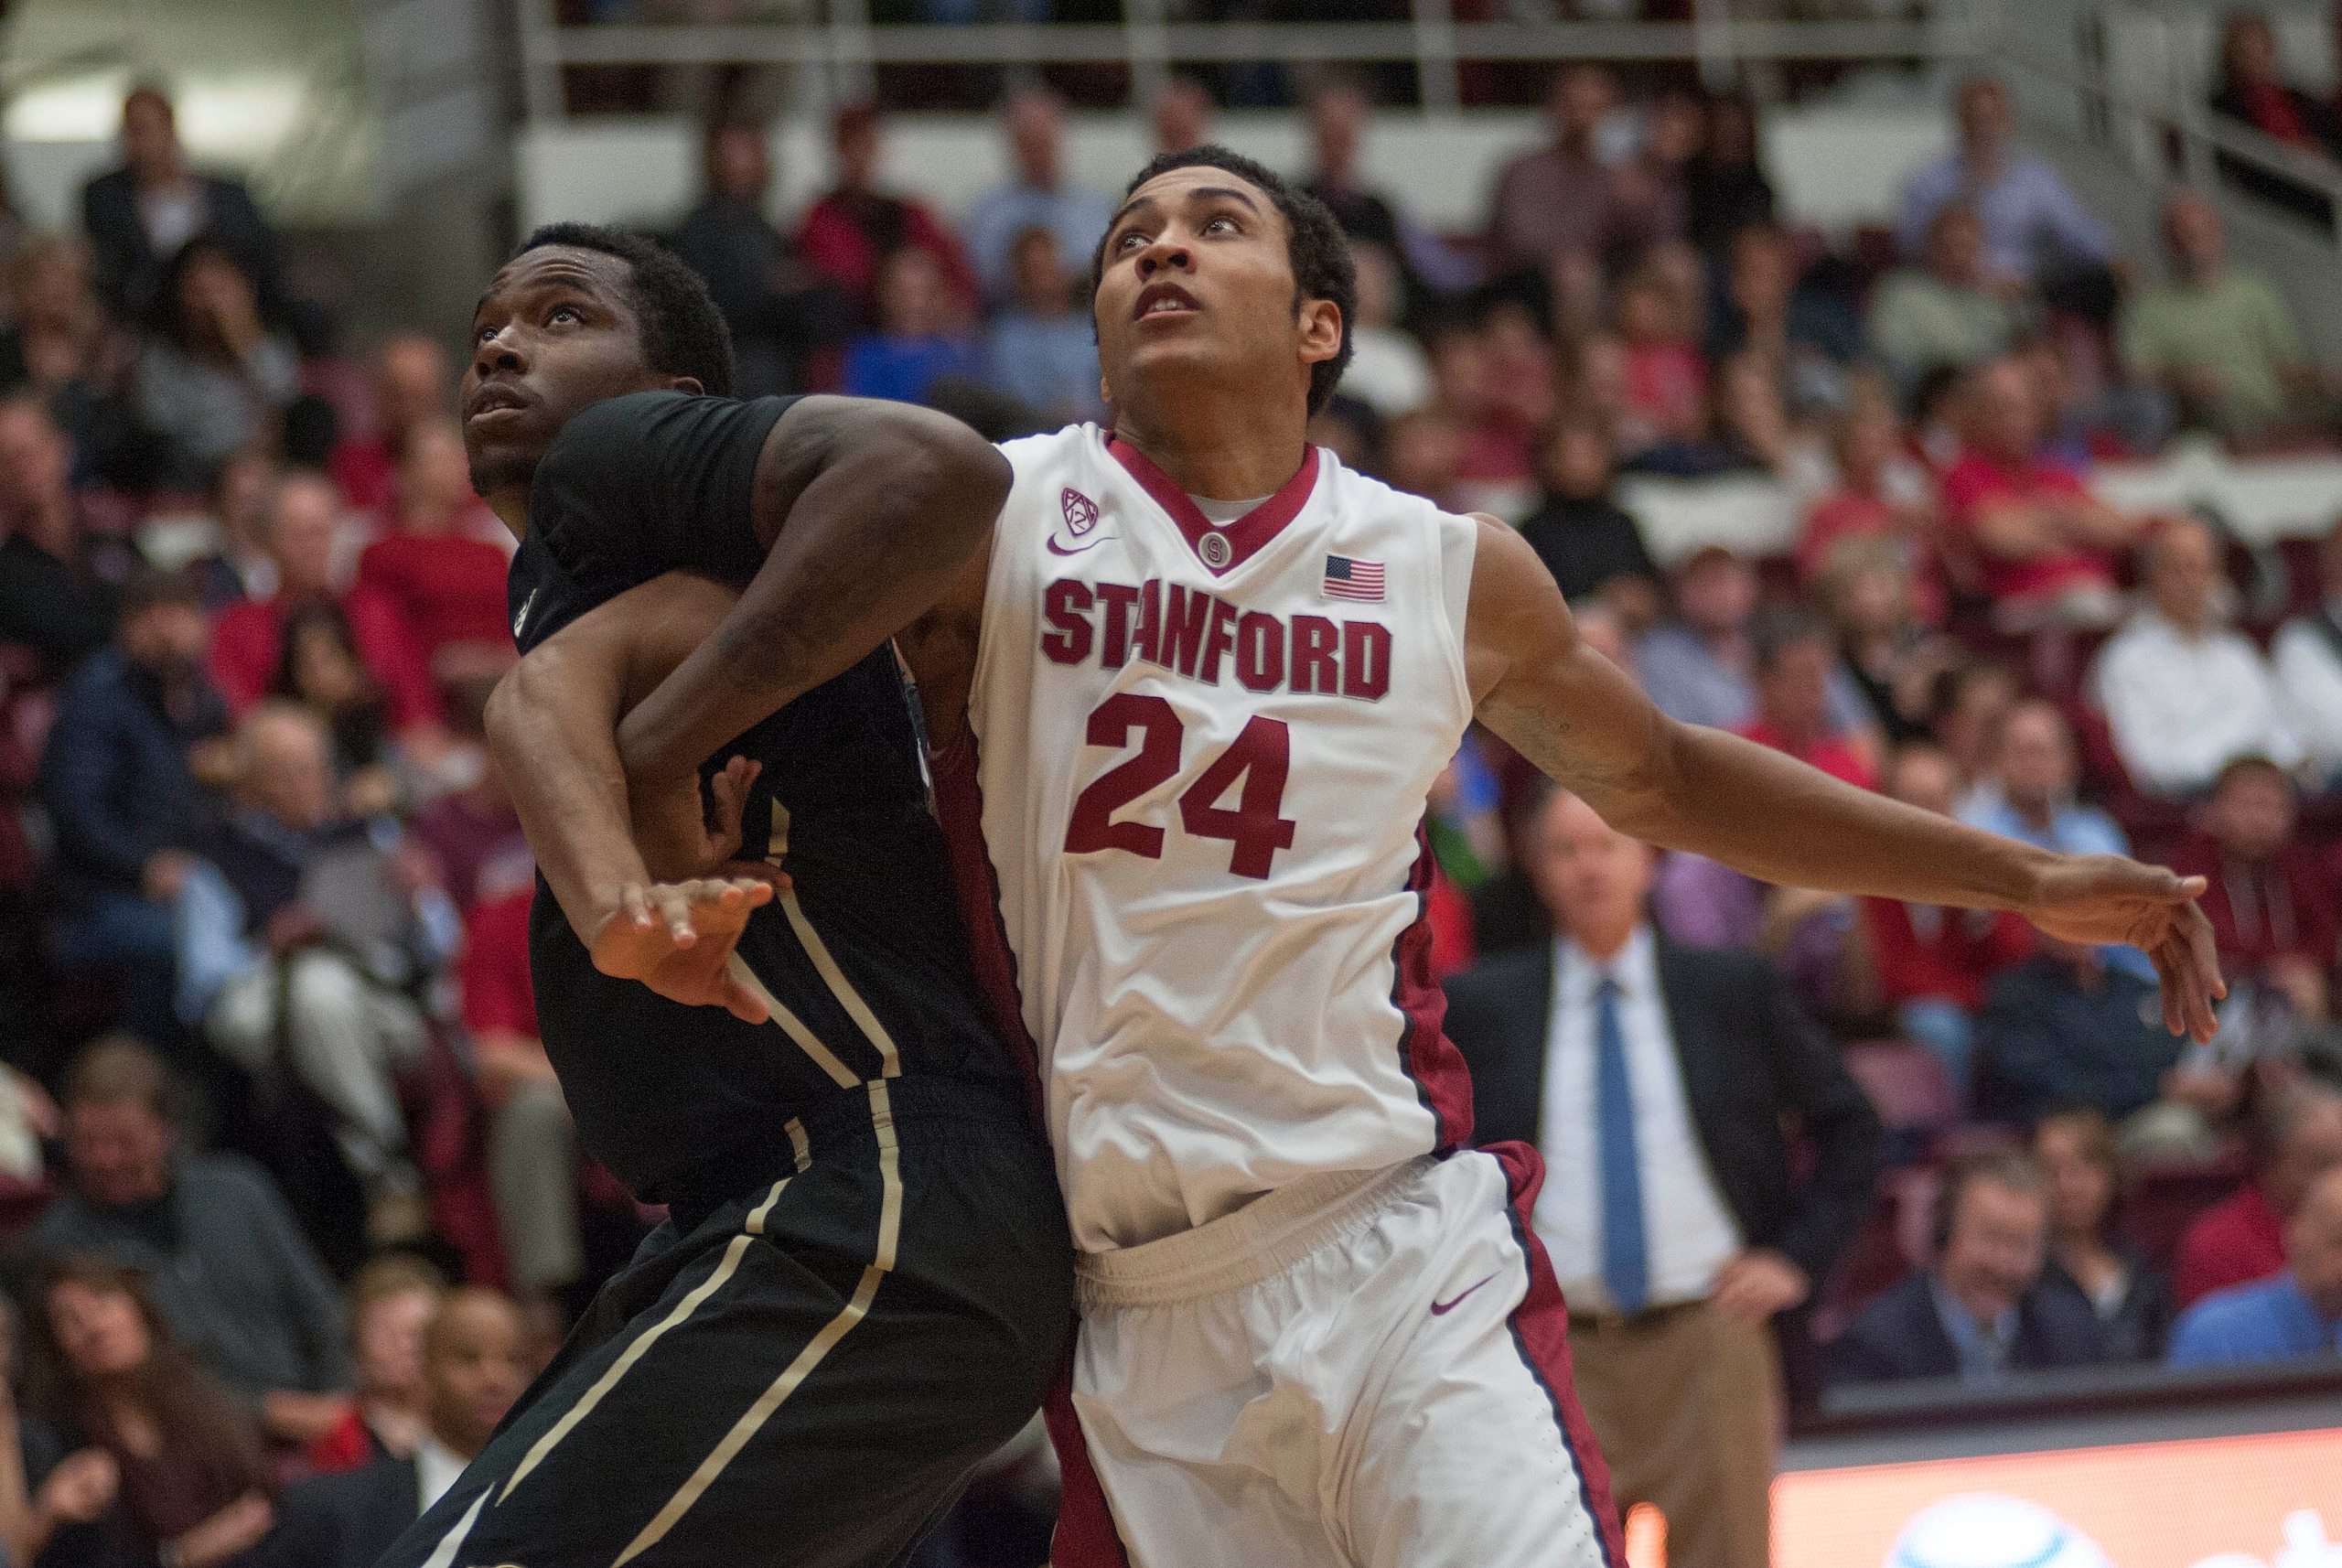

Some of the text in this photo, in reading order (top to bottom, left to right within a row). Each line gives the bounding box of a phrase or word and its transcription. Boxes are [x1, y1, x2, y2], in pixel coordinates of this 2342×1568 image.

[1069, 509, 1087, 530] 12
[1209, 539, 1222, 563] S
[1041, 578, 1393, 703] STANFORD
[1063, 693, 1295, 880] 24
